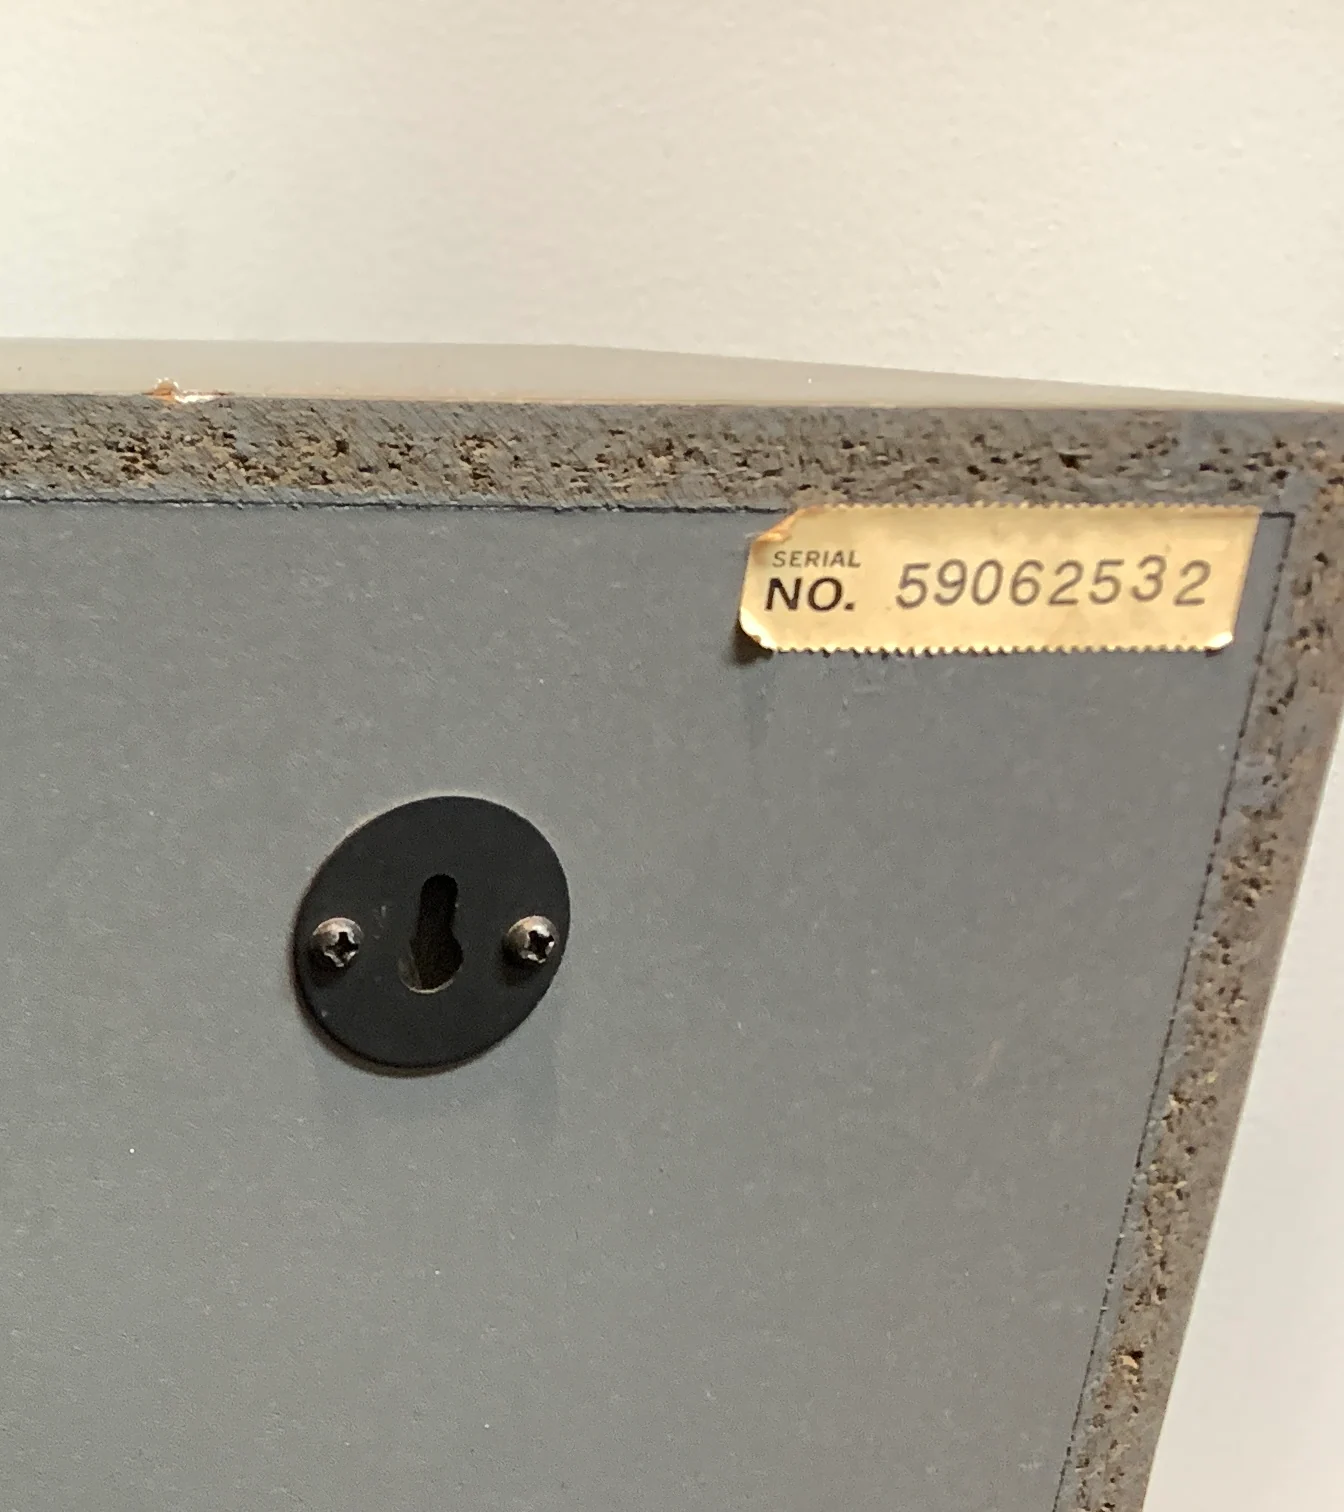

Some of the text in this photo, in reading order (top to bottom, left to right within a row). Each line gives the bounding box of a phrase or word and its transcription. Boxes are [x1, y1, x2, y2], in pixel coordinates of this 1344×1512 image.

[772, 550, 861, 568] SERIAL
[765, 555, 1212, 611] NO. 59062532
